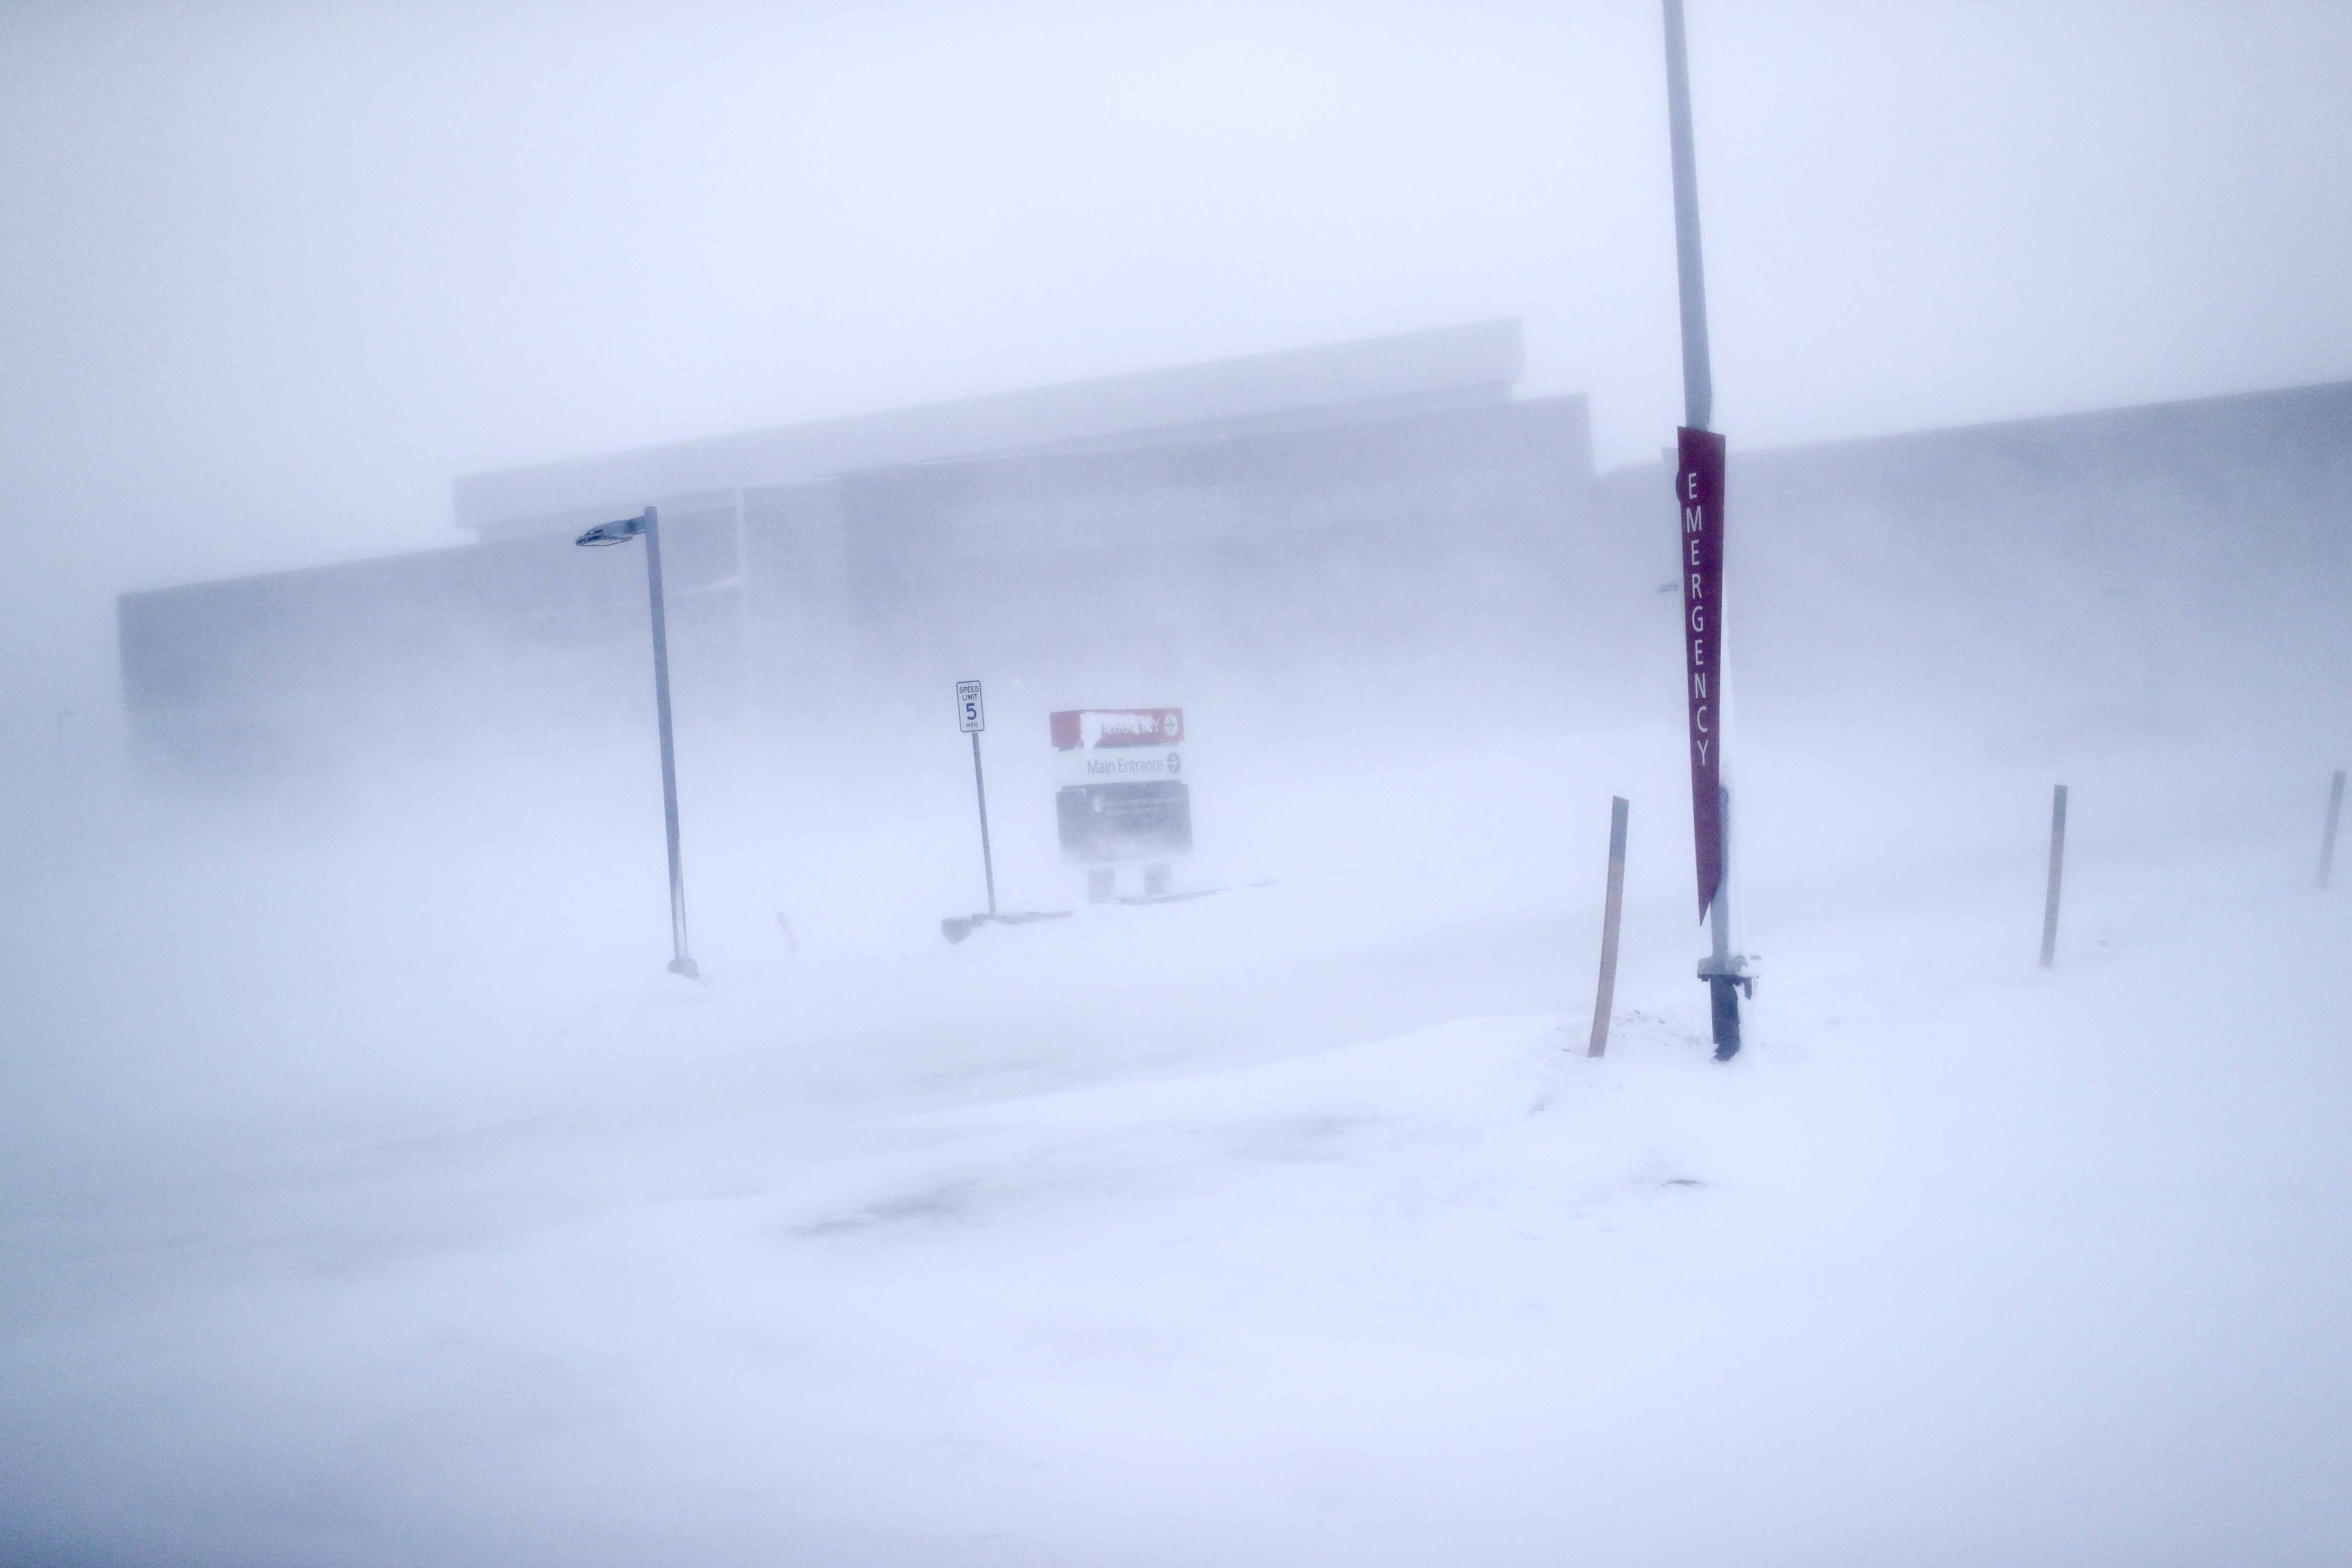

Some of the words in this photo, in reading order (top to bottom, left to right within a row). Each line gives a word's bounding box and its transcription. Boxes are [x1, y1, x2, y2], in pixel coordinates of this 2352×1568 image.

[1686, 472, 1709, 765] EMERGENCY
[966, 703, 977, 720] 5
[1087, 759, 1115, 774] Main
[1118, 758, 1164, 773] Entrance
